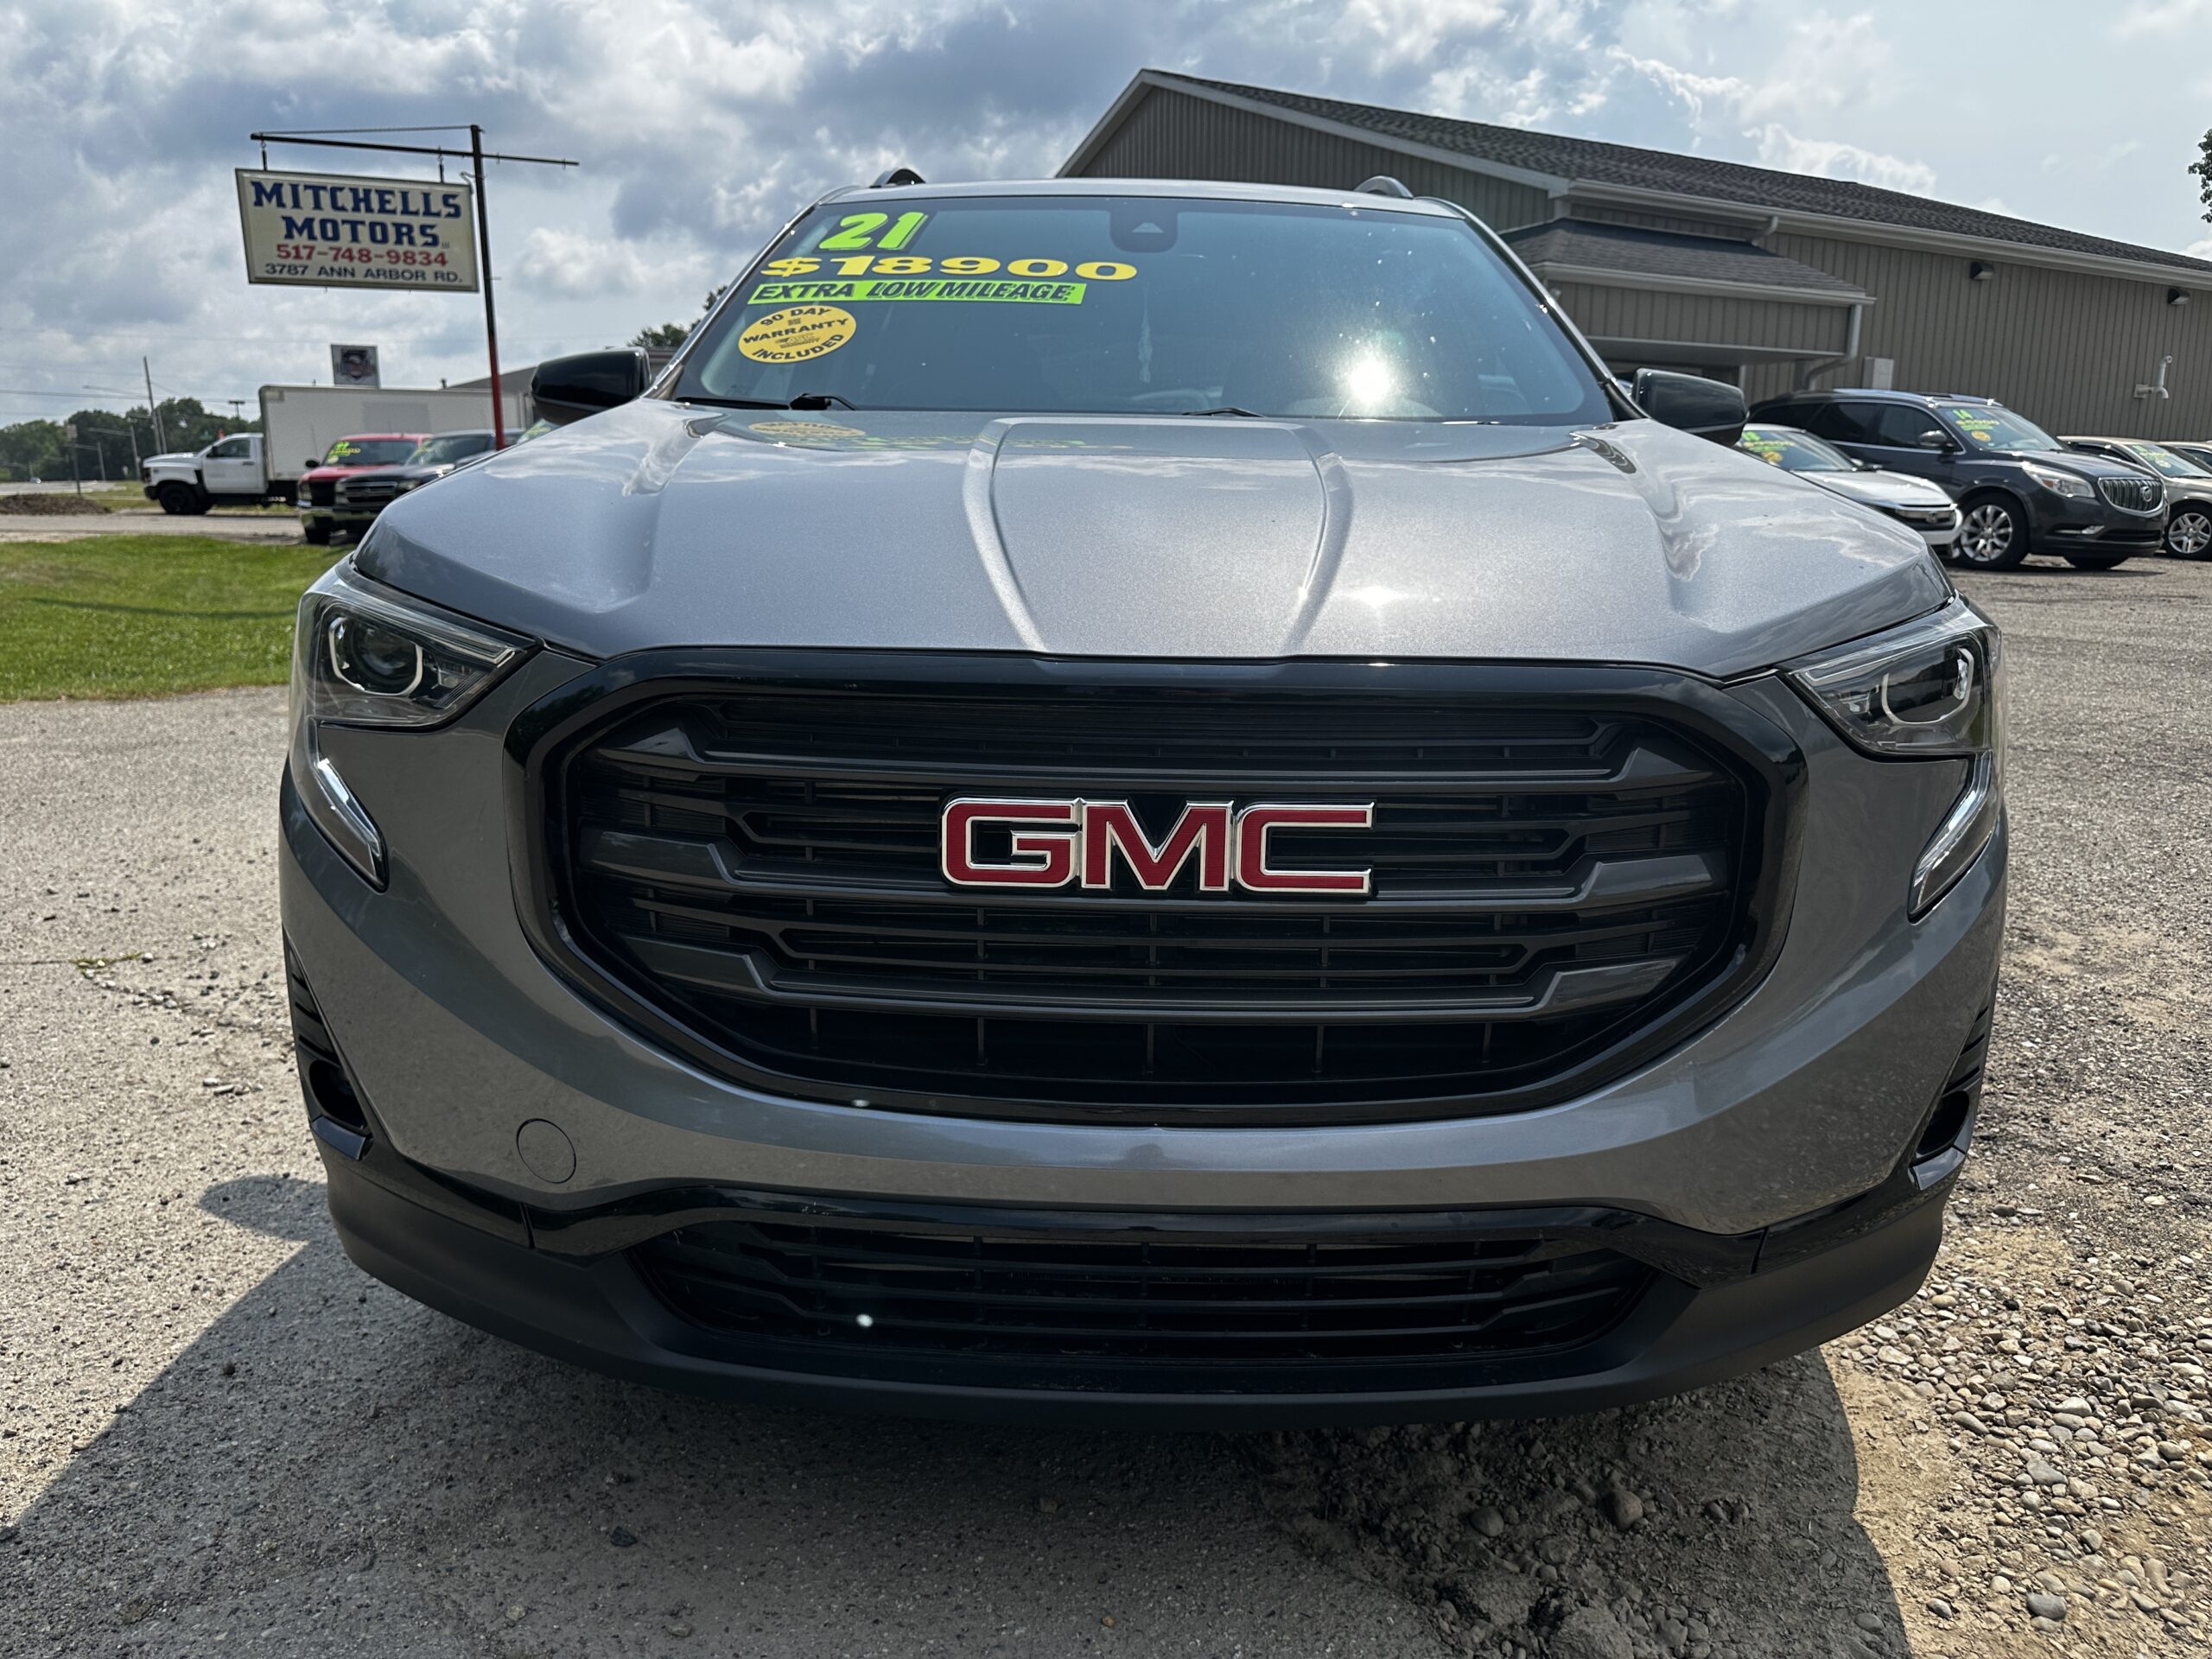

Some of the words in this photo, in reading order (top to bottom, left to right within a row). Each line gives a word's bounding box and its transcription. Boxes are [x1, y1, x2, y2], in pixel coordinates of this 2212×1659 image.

[250, 180, 462, 219] MITCHELLS
[282, 215, 440, 247] MOTORS
[818, 212, 929, 251] 21
[276, 244, 448, 267] 517-748-9834
[760, 255, 1138, 281] $18900
[264, 263, 308, 276] 3787
[317, 264, 356, 278] ANN
[364, 267, 427, 282] ARBOR
[753, 283, 855, 301] EXTRA
[866, 282, 941, 299] LOW
[936, 282, 1075, 302] MILEAGE
[760, 314, 785, 326] 90
[790, 308, 832, 316] DAY
[743, 318, 849, 344] WARRANTY
[752, 334, 844, 359] INCLUDED
[941, 797, 1376, 894] GMC
